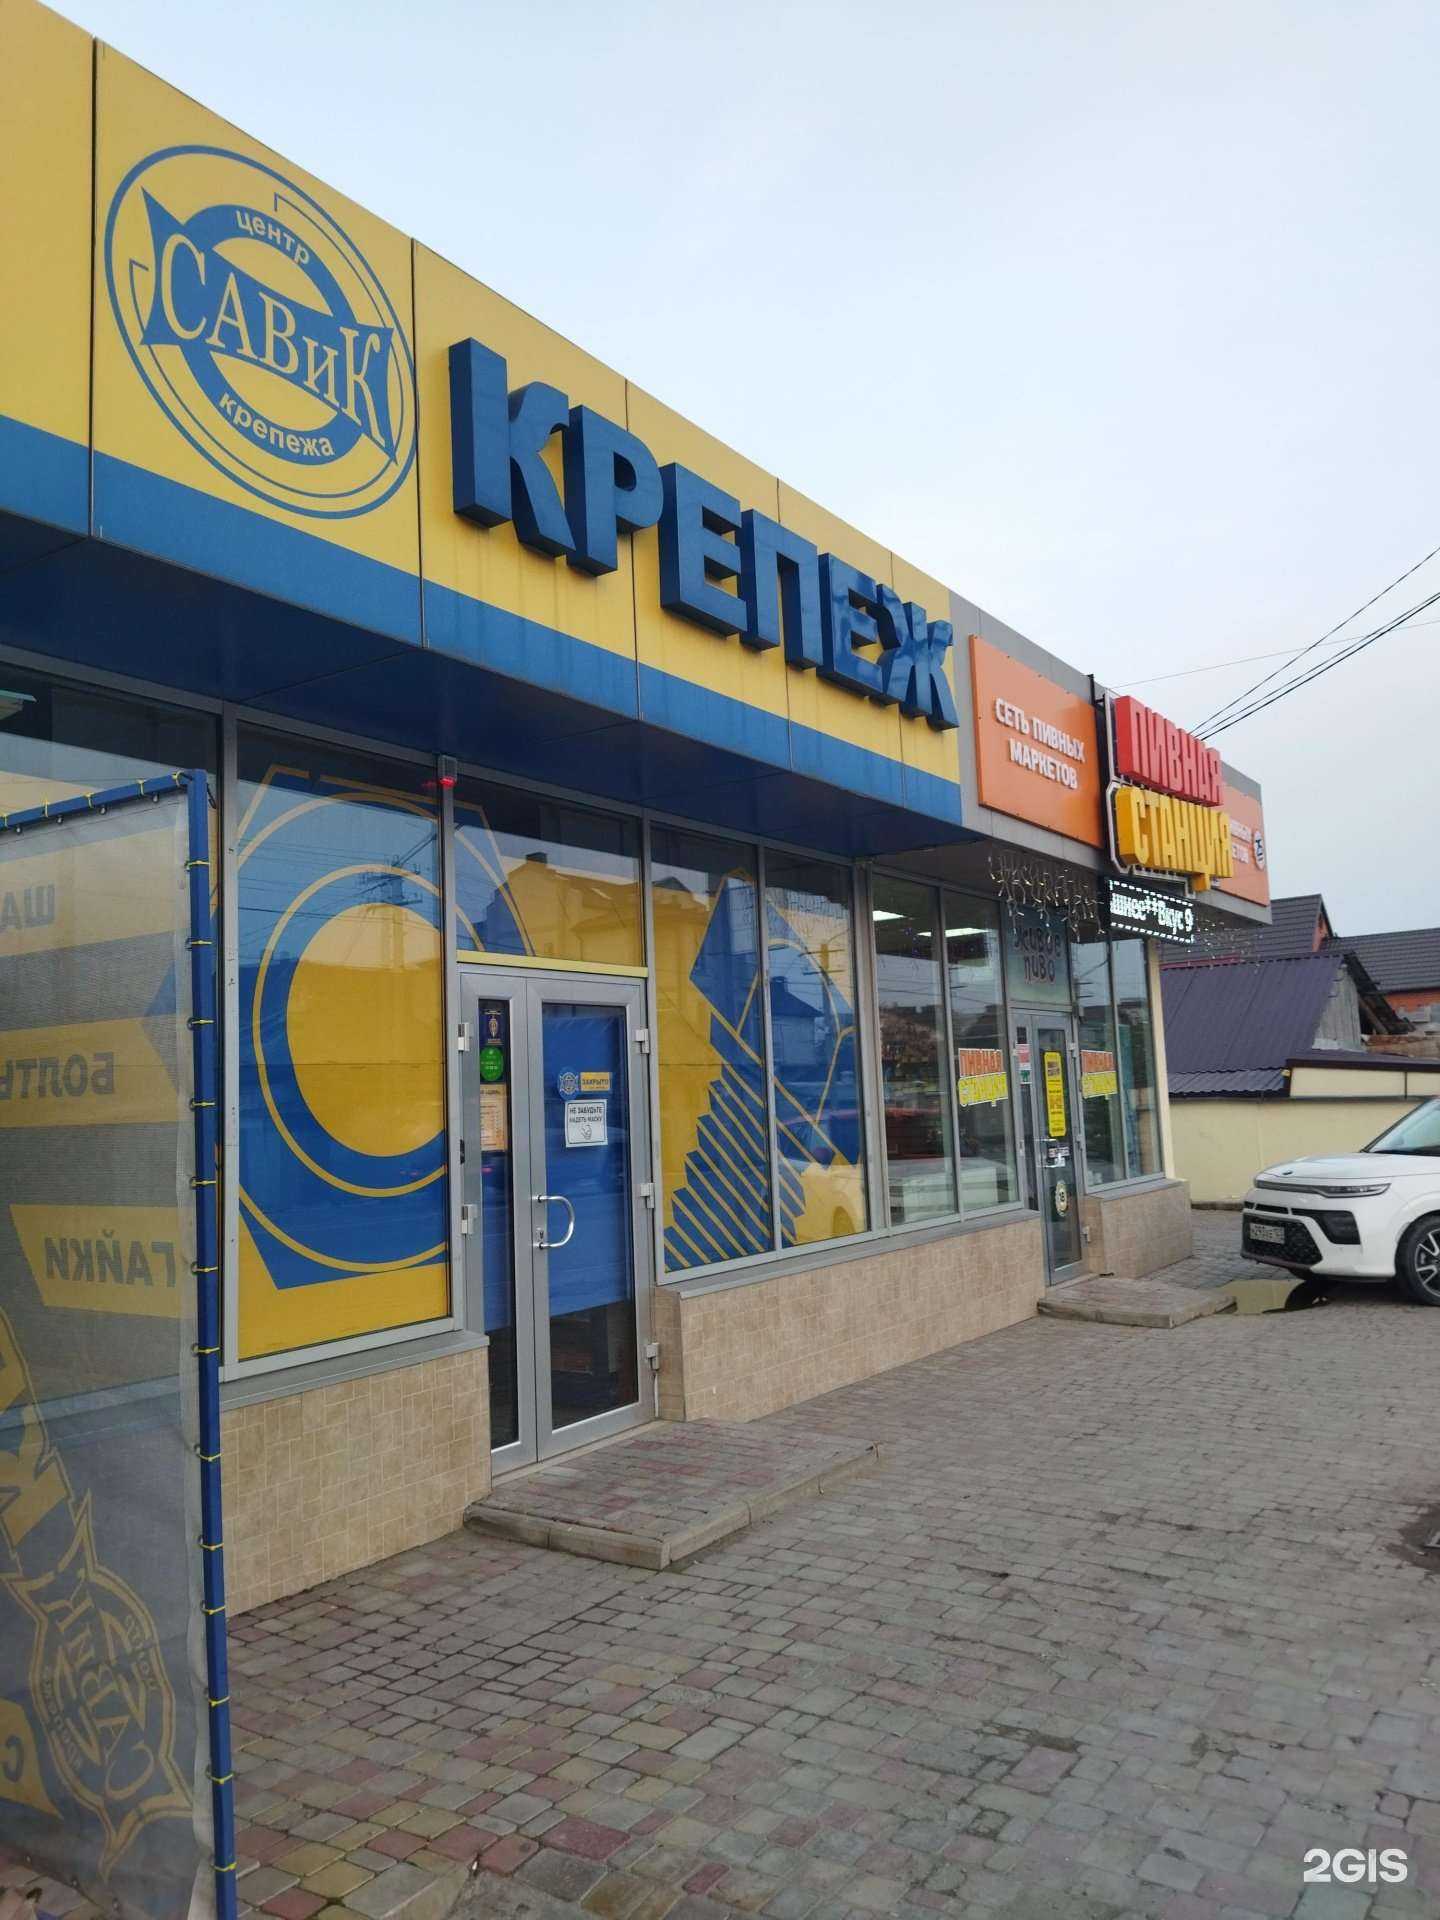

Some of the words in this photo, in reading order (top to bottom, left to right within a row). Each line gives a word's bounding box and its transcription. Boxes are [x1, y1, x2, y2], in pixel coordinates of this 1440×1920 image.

[235, 210, 310, 265] центр
[161, 232, 387, 448] САВиК
[219, 393, 335, 458] крепежа
[448, 337, 959, 731] КРЕПЕЖ
[995, 697, 1030, 735] СЕТЬ
[1031, 717, 1086, 764] ПИВНЫХ
[1008, 737, 1078, 790] МАРКЕТОВ
[1115, 695, 1224, 807] ПИВНАЯ
[1115, 783, 1234, 892] СТАНЦИЯ
[569, 1106, 577, 1114] НЕ
